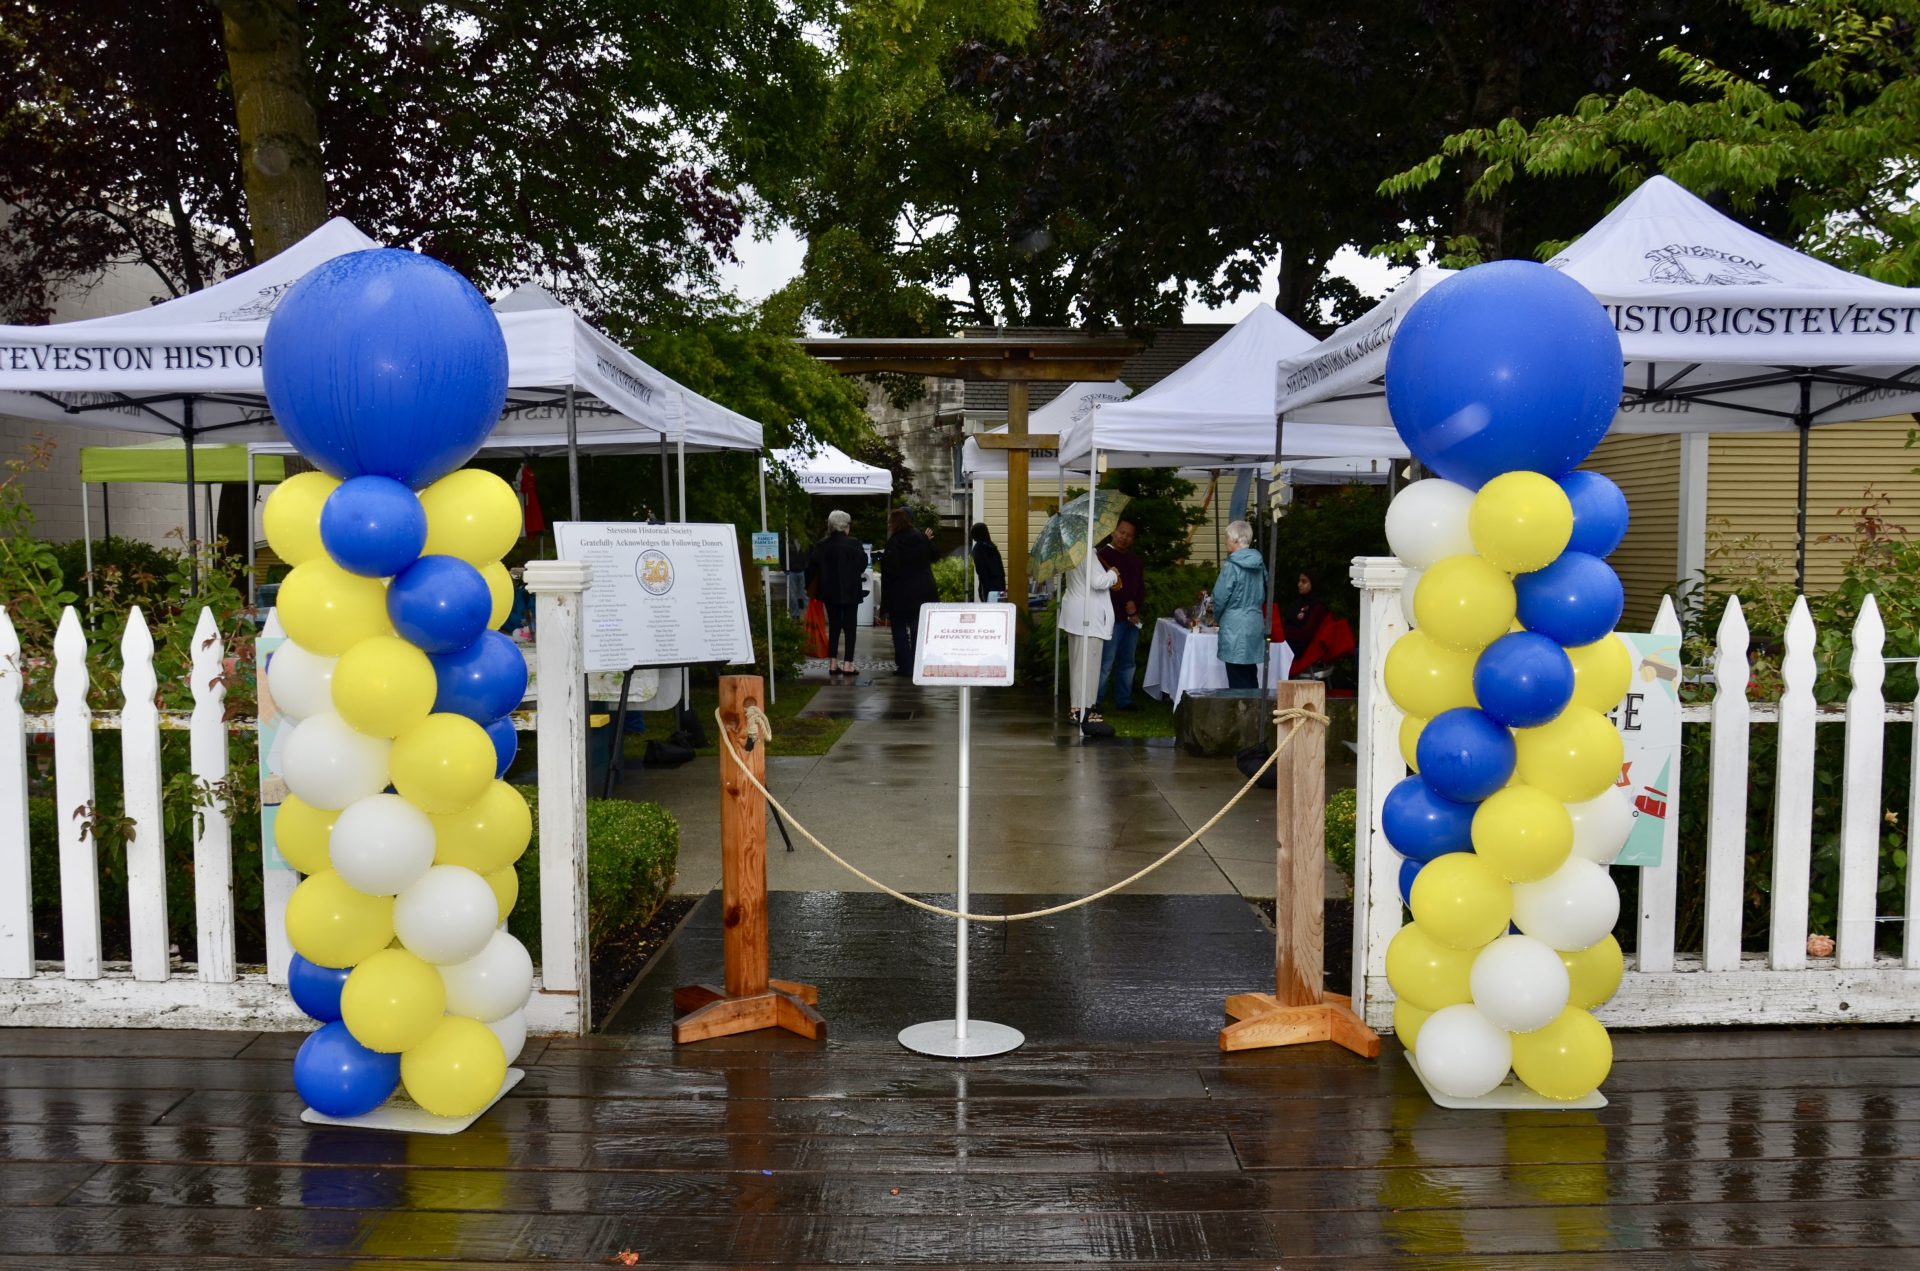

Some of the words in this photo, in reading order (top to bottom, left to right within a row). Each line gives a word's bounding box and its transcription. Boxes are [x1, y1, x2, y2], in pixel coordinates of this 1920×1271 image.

[1644, 244, 1767, 271] STEVESTON
[258, 279, 298, 296] STE
[1602, 302, 1920, 336] ISTORICSTEVEST
[1080, 393, 1127, 403] STEVESTO
[829, 475, 870, 485] SOCIETY
[639, 527, 670, 535] Historical
[671, 528, 693, 536] Society
[580, 539, 614, 548] Gratefully
[616, 539, 660, 548] Acknowledges
[672, 539, 701, 548] Following
